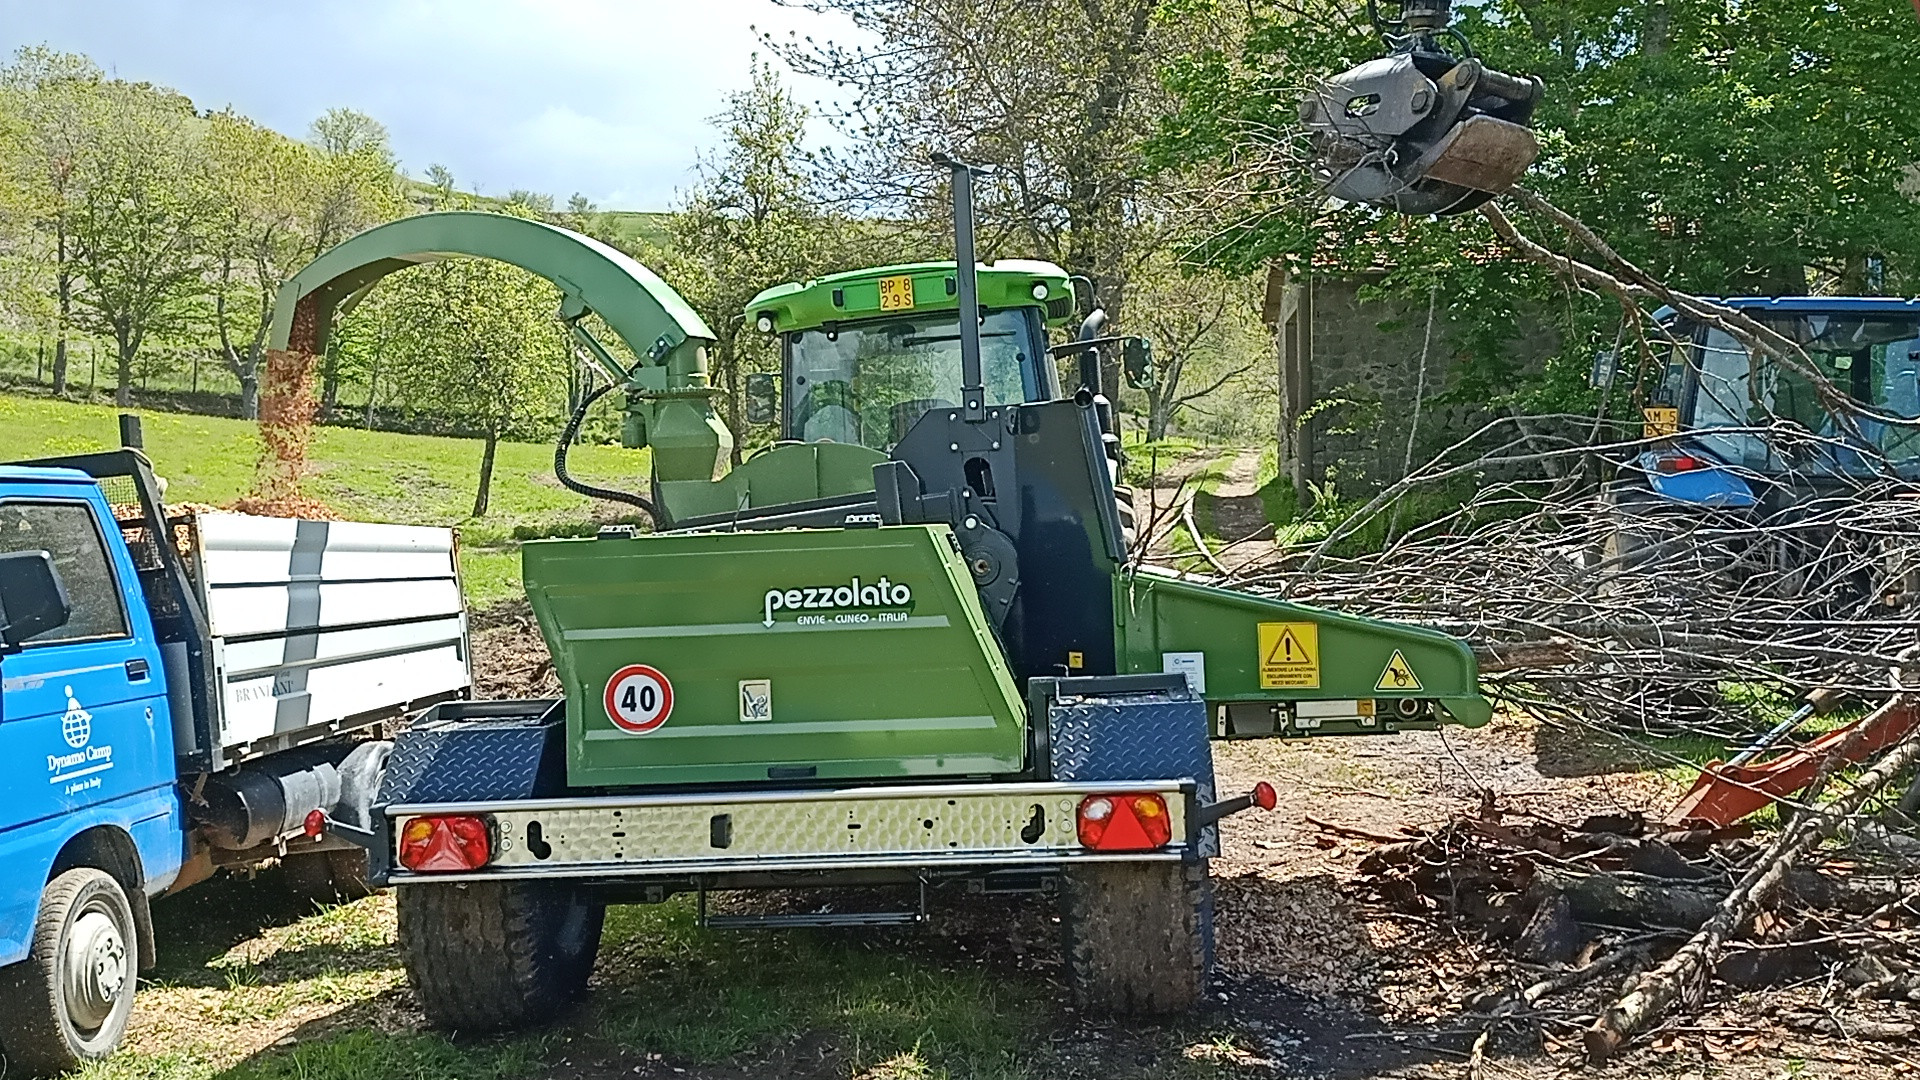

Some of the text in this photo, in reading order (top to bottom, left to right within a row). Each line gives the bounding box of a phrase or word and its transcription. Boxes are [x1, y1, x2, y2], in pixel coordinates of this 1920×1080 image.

[880, 278, 911, 294] BP 8
[762, 576, 911, 629] pezzolato
[797, 614, 826, 625] ENVIE
[834, 613, 870, 624] CUNEO
[878, 612, 908, 622] ITALIA
[621, 685, 656, 712] 40
[46, 751, 86, 775] Dynamo
